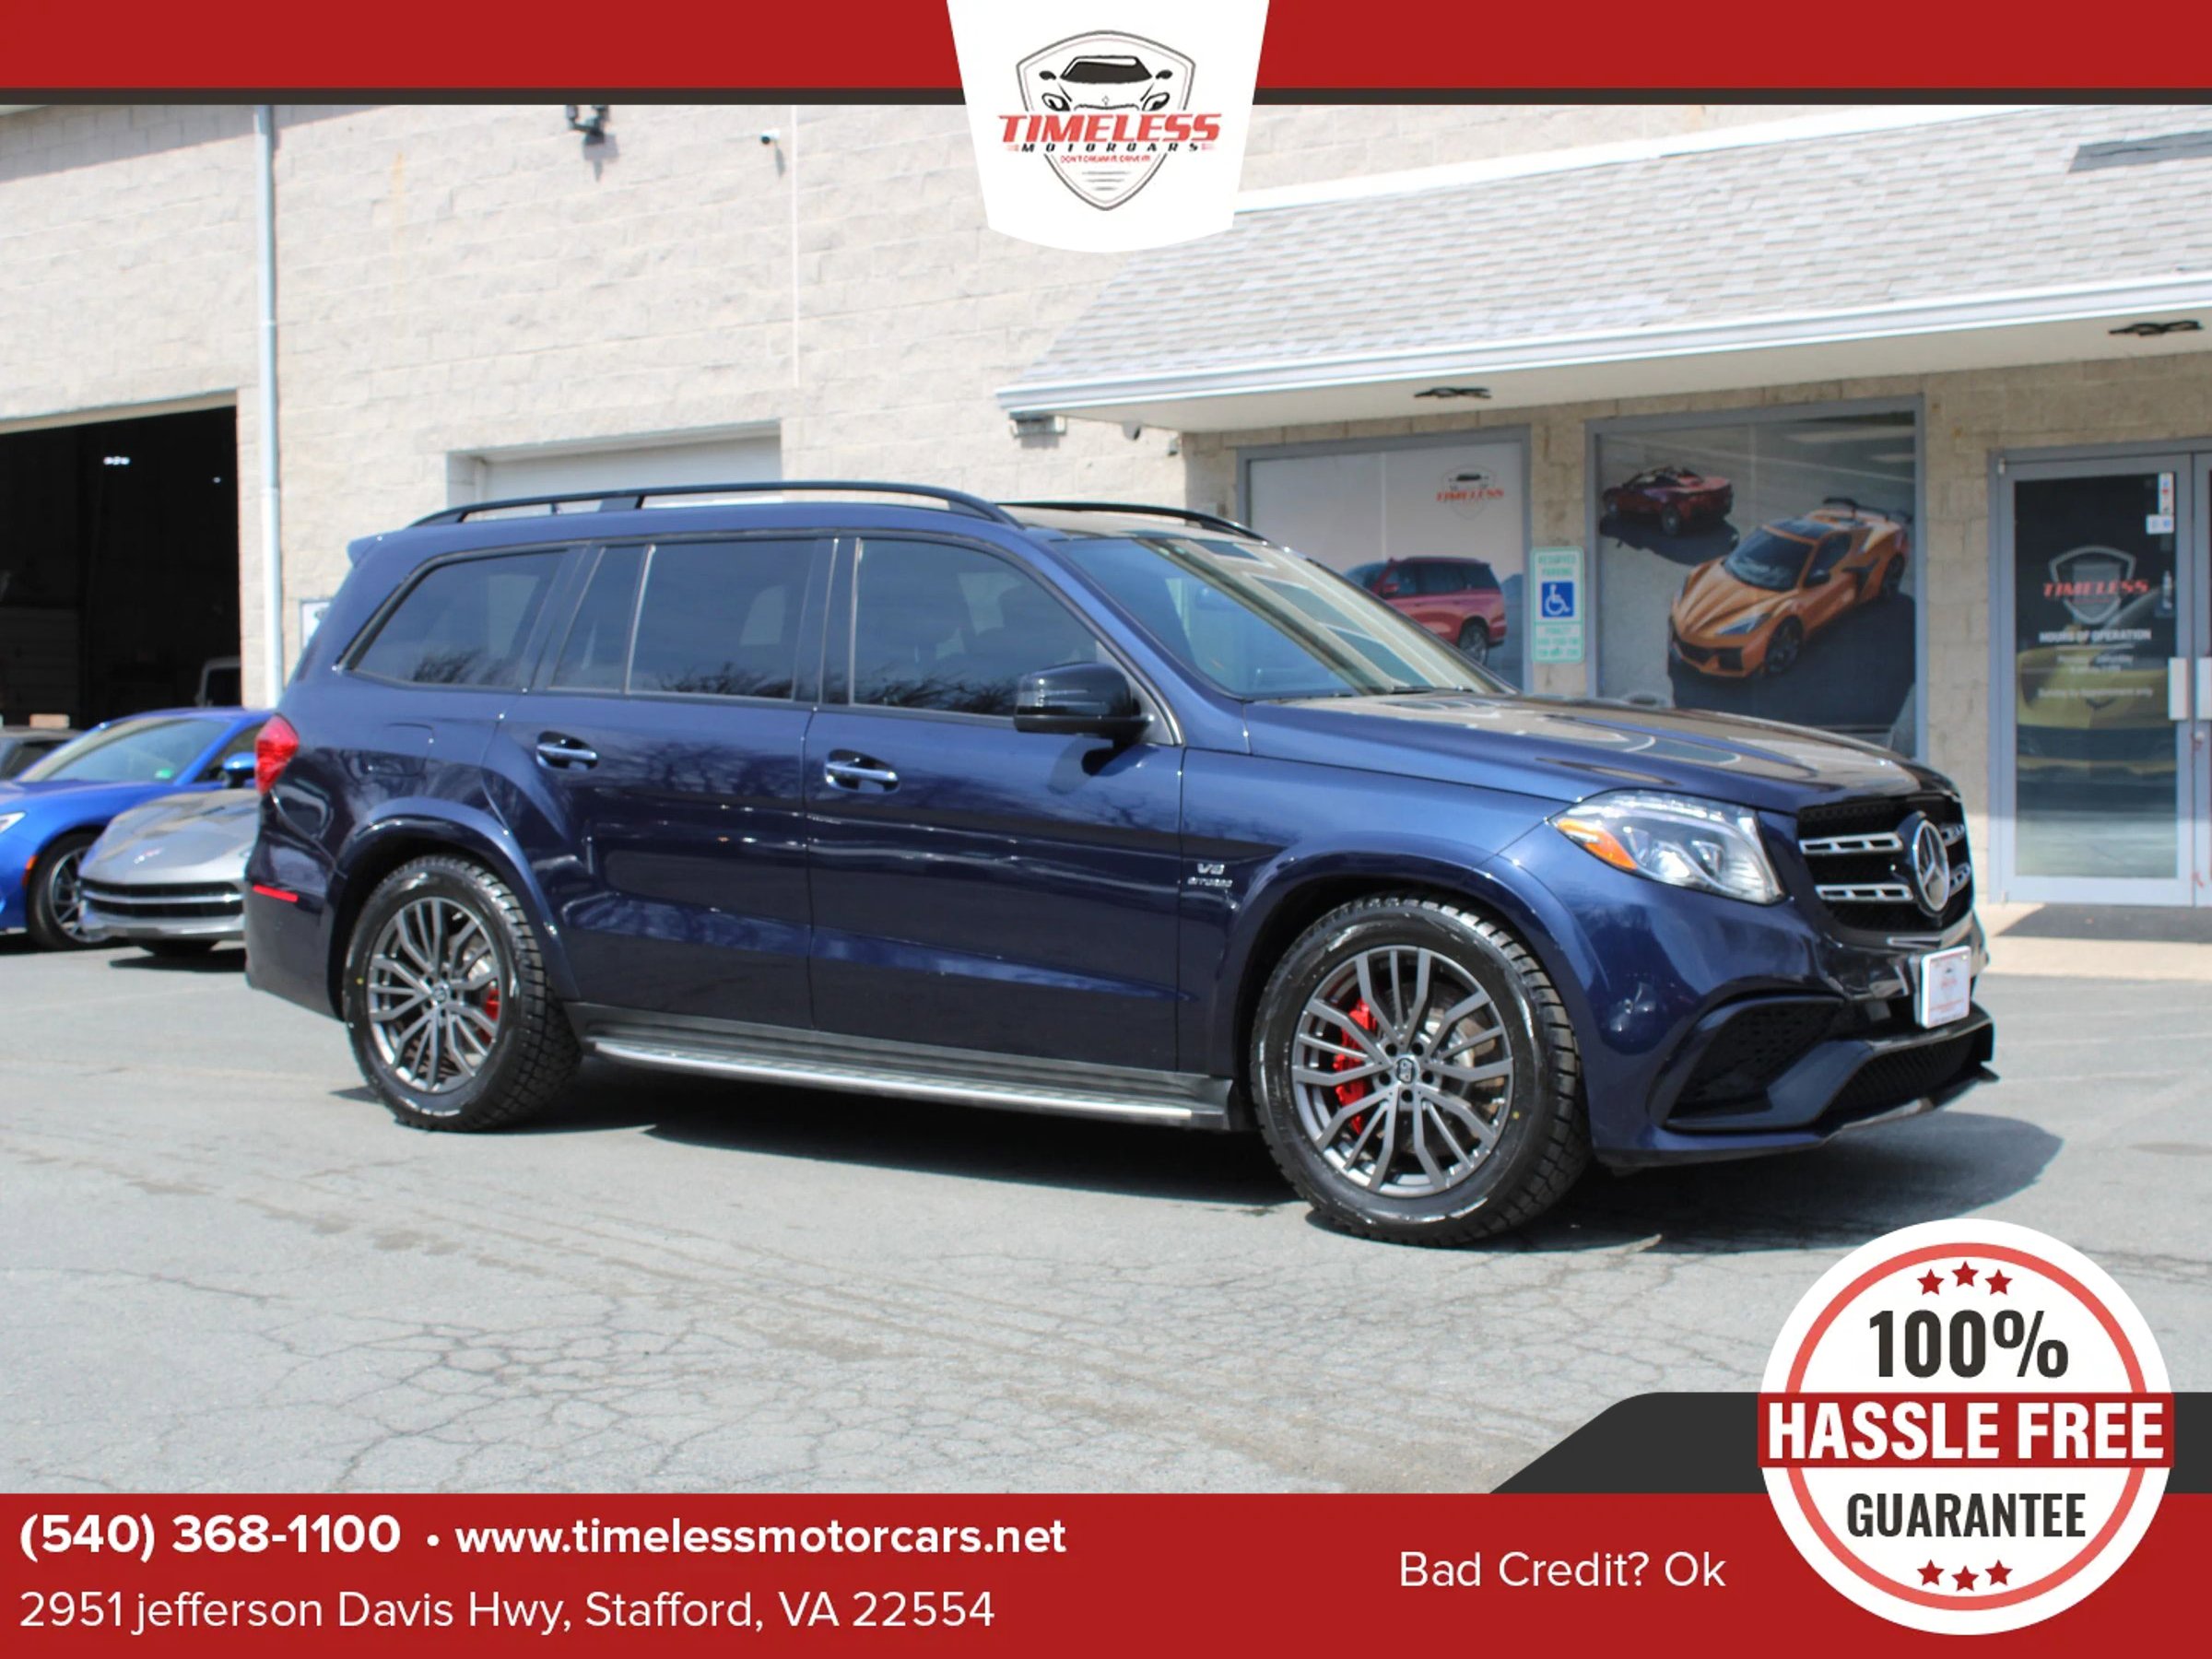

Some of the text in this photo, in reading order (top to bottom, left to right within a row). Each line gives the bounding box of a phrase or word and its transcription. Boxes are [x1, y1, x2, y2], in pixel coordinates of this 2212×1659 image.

[2042, 581, 2149, 598] TIMELESS
[2039, 629, 2152, 643] HOURS OF OPERATION
